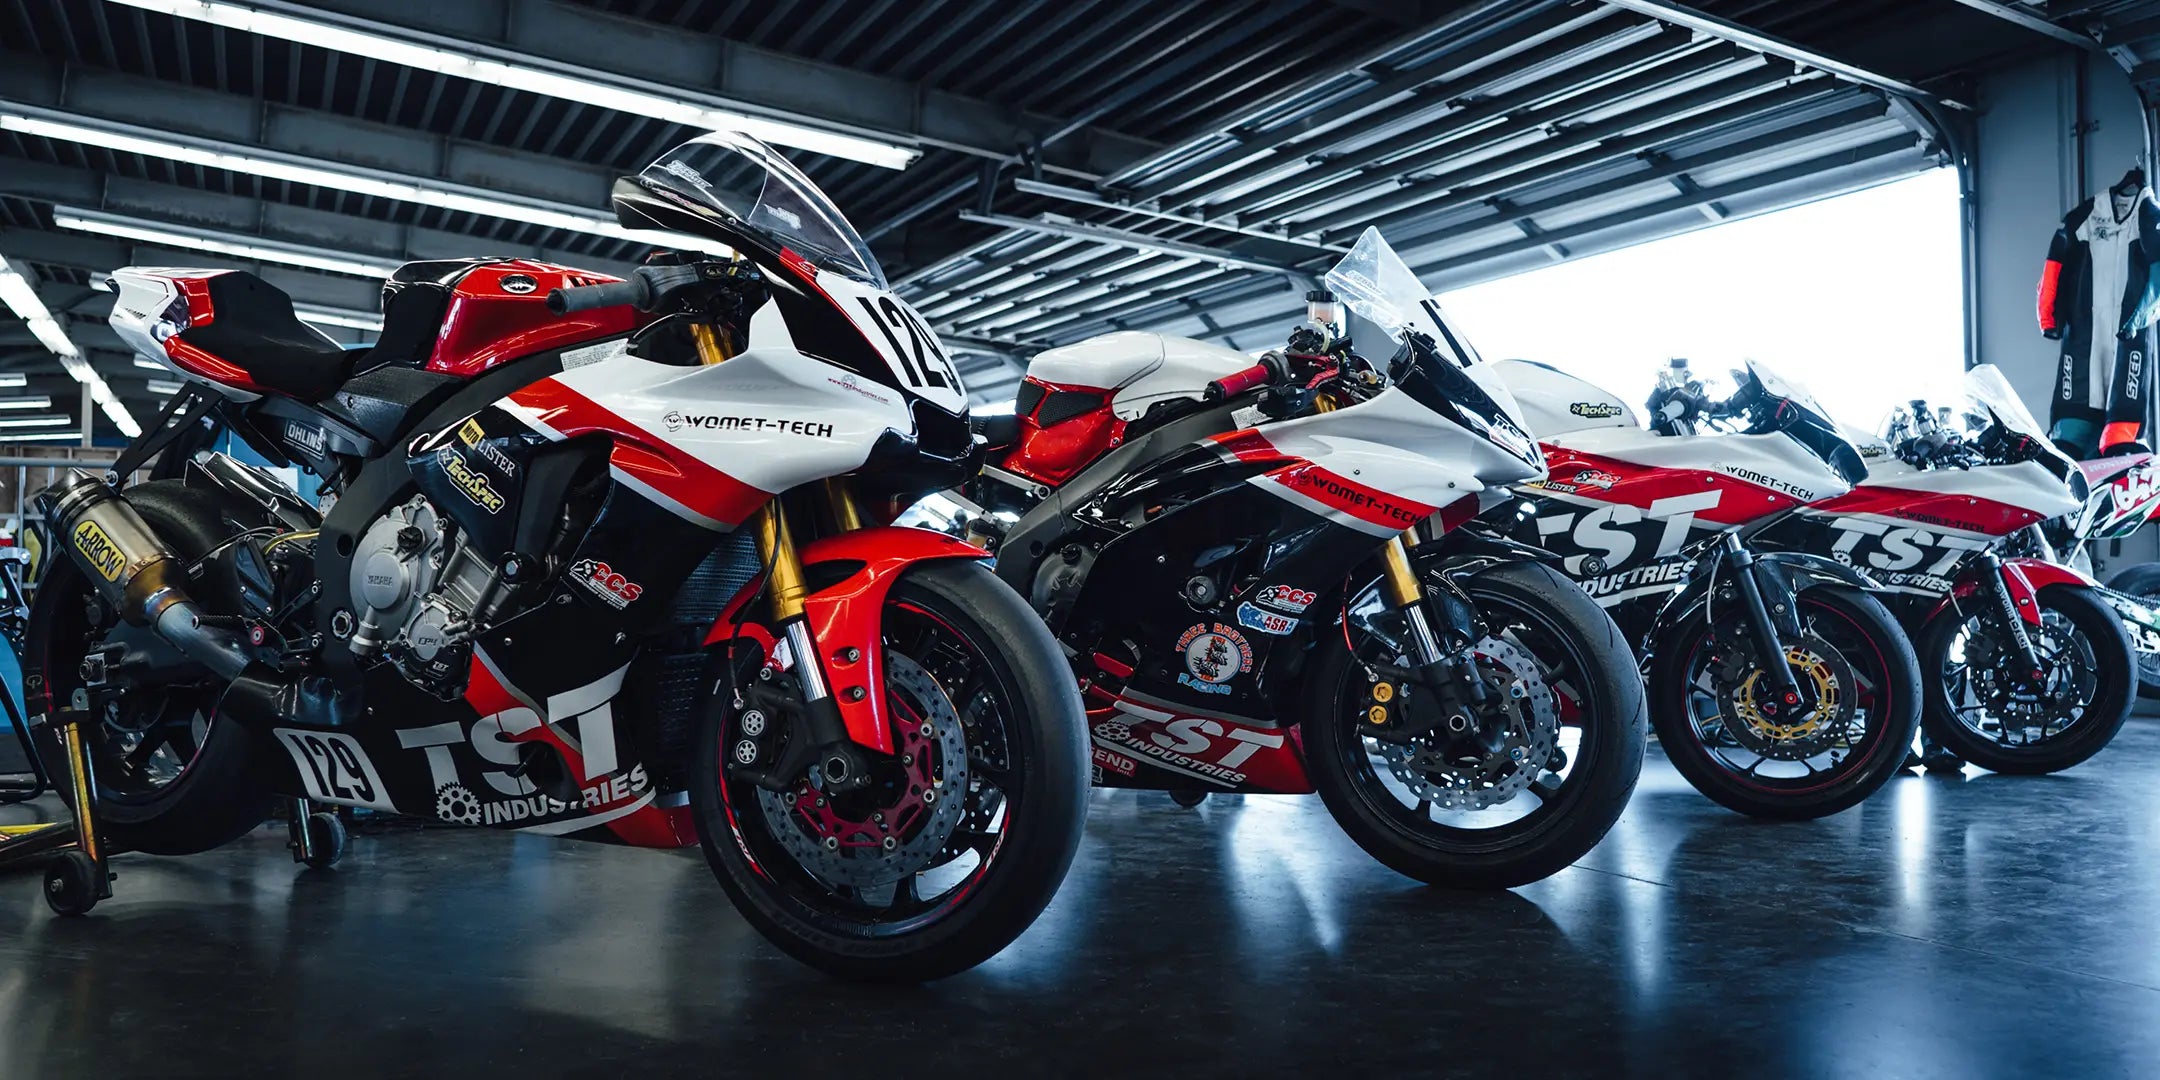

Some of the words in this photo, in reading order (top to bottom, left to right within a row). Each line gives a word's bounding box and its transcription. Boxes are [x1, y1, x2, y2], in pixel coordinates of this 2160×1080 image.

[856, 296, 962, 397] 129
[462, 423, 480, 444] MOTO
[478, 438, 516, 477] LISTER
[685, 414, 833, 438] WOMET-TECH
[1545, 481, 1577, 493] LISTER
[1726, 466, 1814, 500] WOMET-TECH
[75, 525, 124, 577] ARROW
[1830, 517, 1990, 577] TST
[593, 562, 643, 601] CCS
[1276, 584, 1317, 605] CCS
[1175, 623, 1207, 653] THREE
[1213, 622, 1253, 673] BROTHERS
[1177, 672, 1232, 695] RACING
[395, 661, 632, 796] TST
[1108, 700, 1284, 769] TST
[288, 733, 376, 803] 129
[1125, 737, 1247, 783] INDUSTRIES
